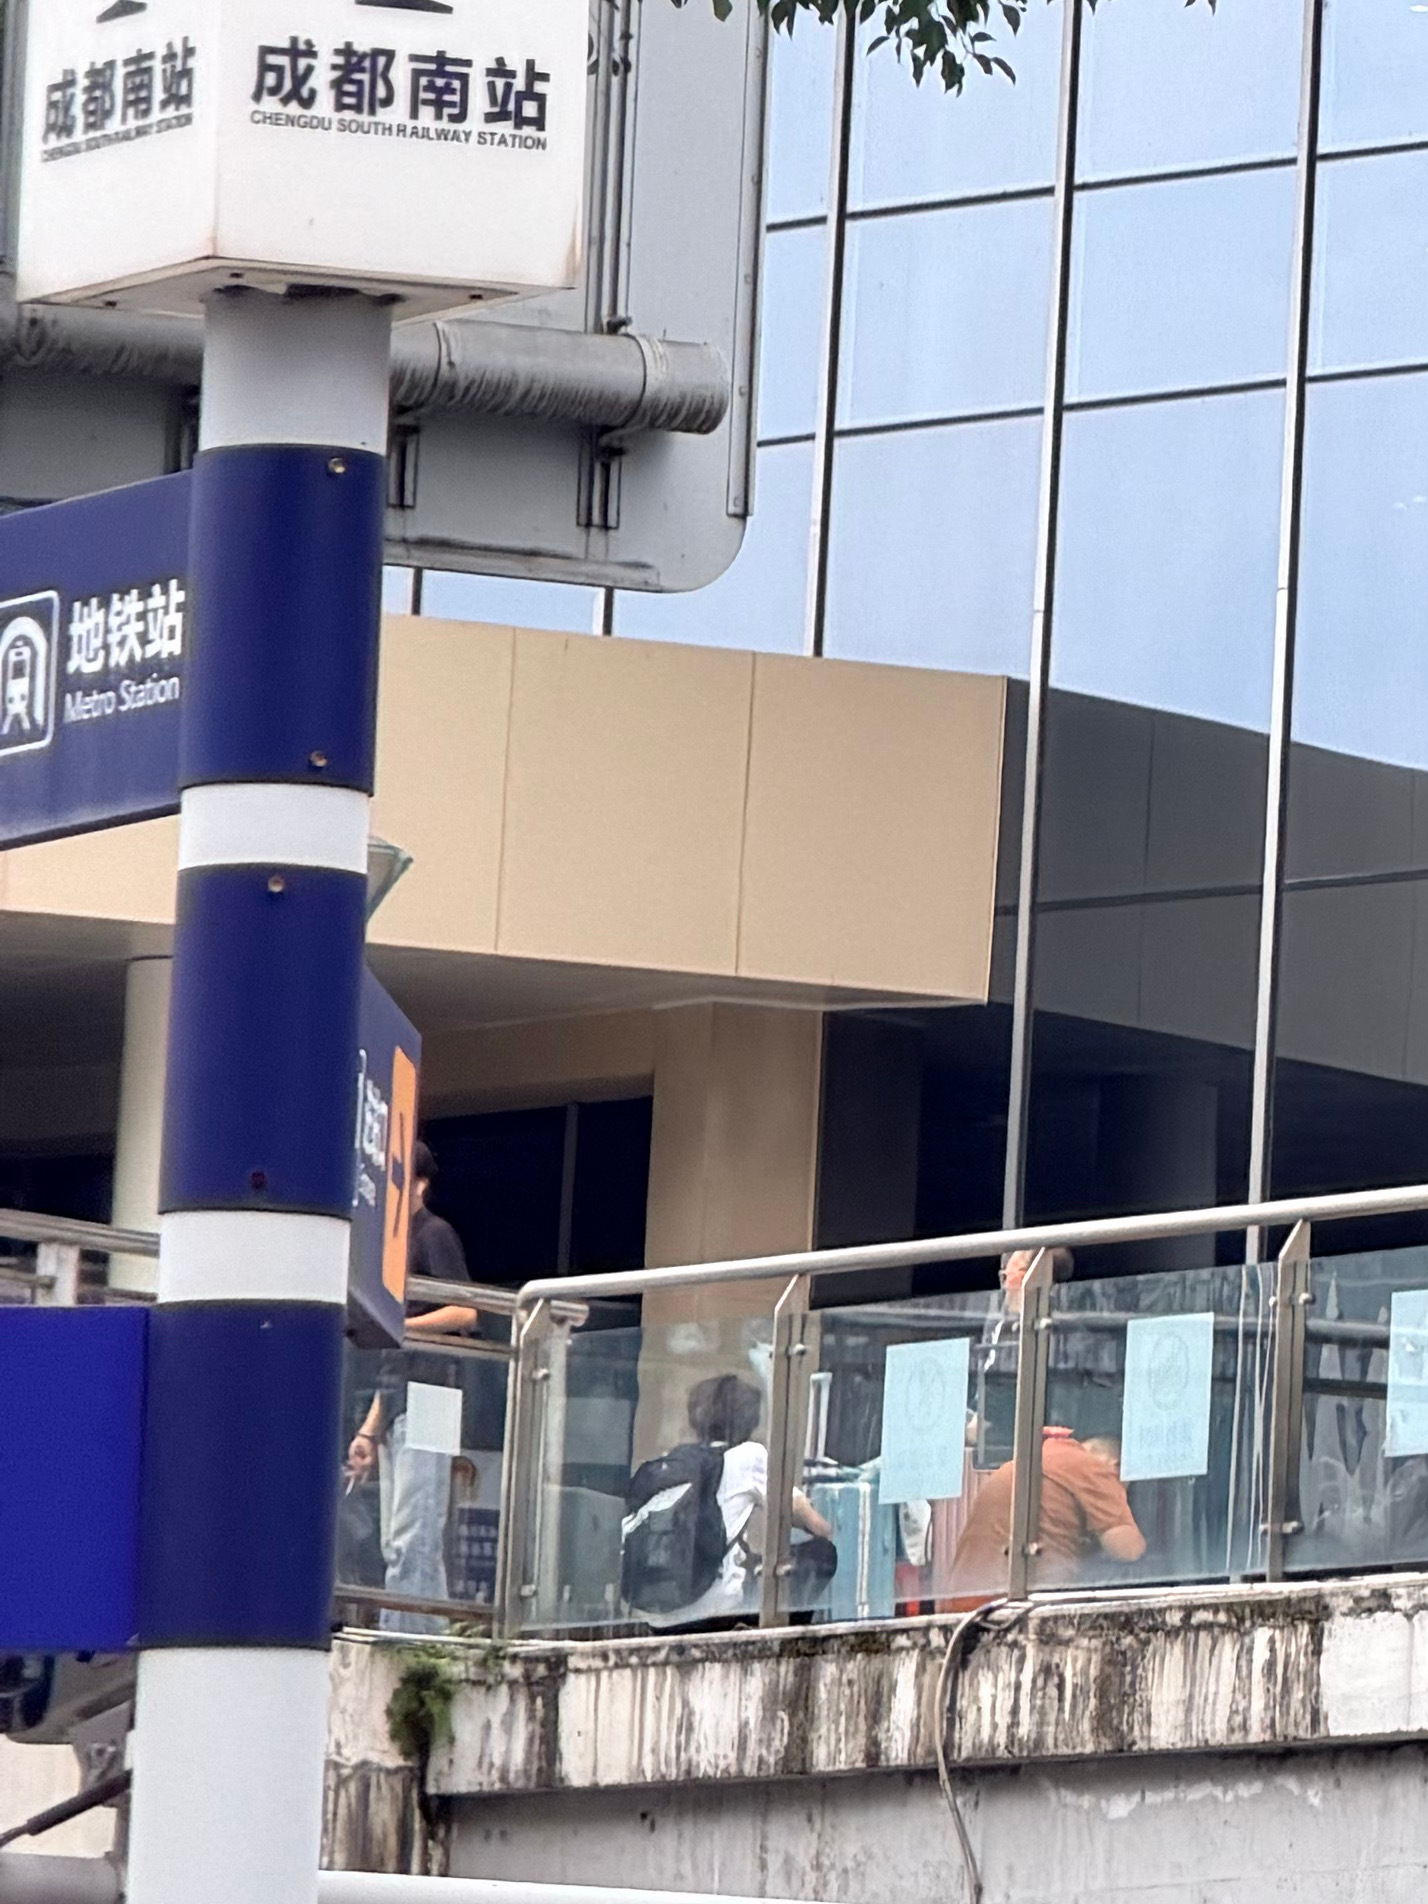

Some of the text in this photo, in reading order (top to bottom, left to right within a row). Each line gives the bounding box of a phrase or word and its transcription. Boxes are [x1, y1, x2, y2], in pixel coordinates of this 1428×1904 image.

[43, 36, 196, 144] 成都南站
[250, 109, 548, 151] CHENGDU SOUTH RAILWAY STATION
[251, 36, 550, 131] 成都南站
[67, 579, 185, 674] 地铁站
[63, 673, 180, 723] Metro Station
